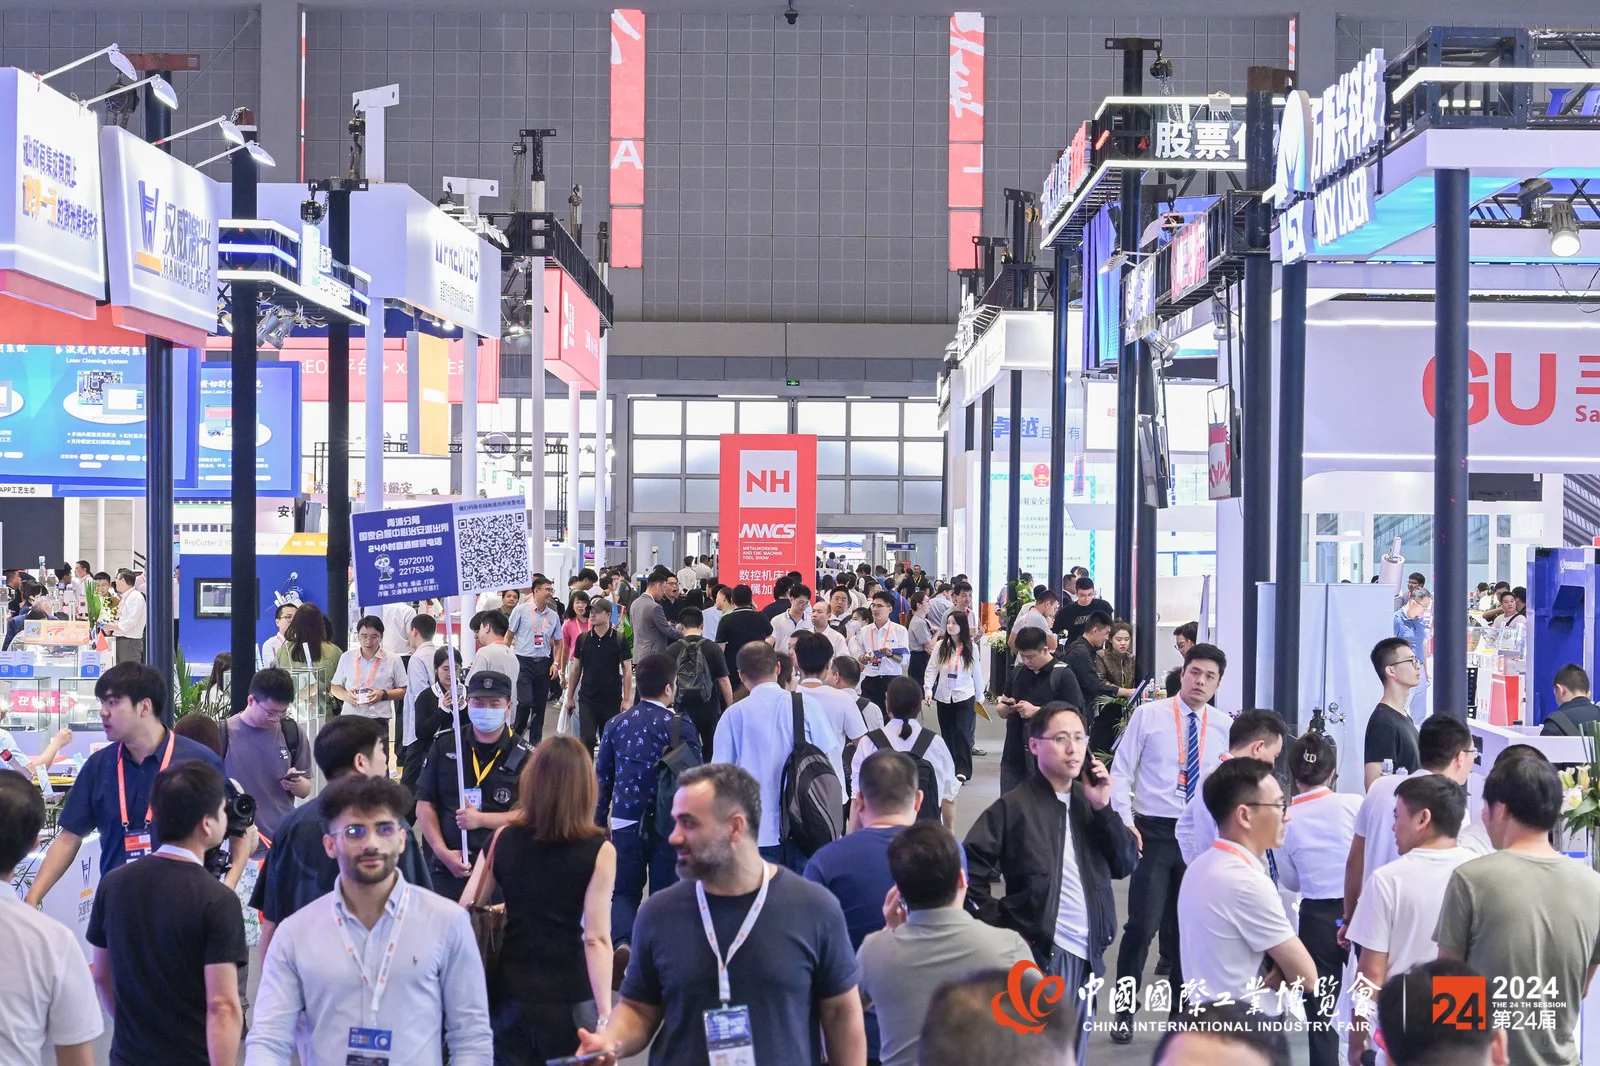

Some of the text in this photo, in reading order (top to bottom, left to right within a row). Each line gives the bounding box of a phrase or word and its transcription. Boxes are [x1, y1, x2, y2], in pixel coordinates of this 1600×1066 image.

[746, 470, 790, 493] NH
[359, 522, 449, 542] 国家会展中心治安派出所
[739, 523, 797, 538] MWCS
[398, 555, 433, 566] 59720110
[398, 565, 434, 576] 22175349
[739, 570, 790, 581] 数控机床
